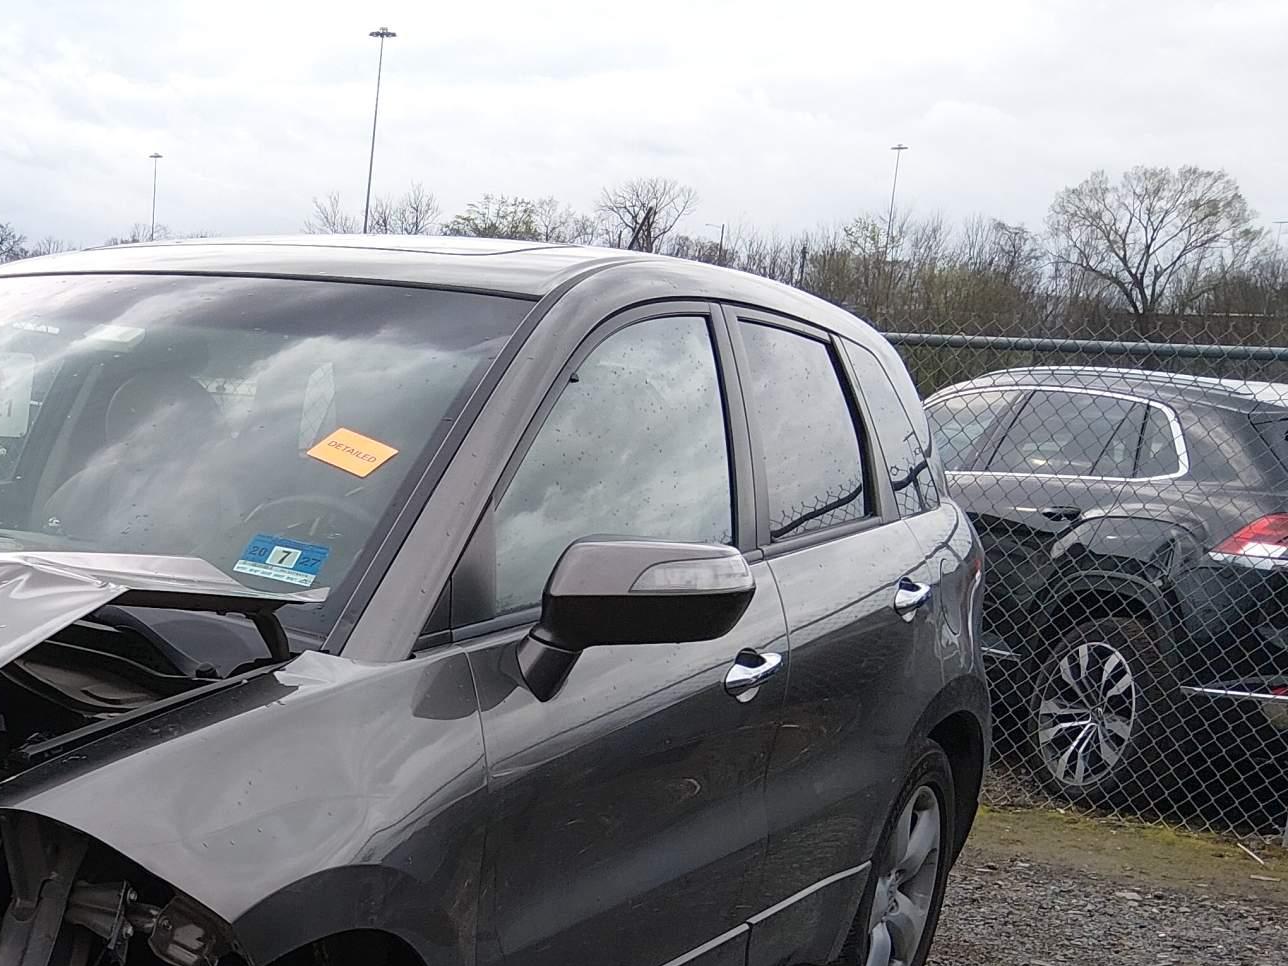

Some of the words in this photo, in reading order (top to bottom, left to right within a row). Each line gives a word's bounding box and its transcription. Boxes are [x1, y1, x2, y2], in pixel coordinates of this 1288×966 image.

[327, 440, 377, 463] DETAILED
[248, 545, 268, 557] 20
[277, 550, 293, 565] 7
[298, 556, 321, 568] 27
